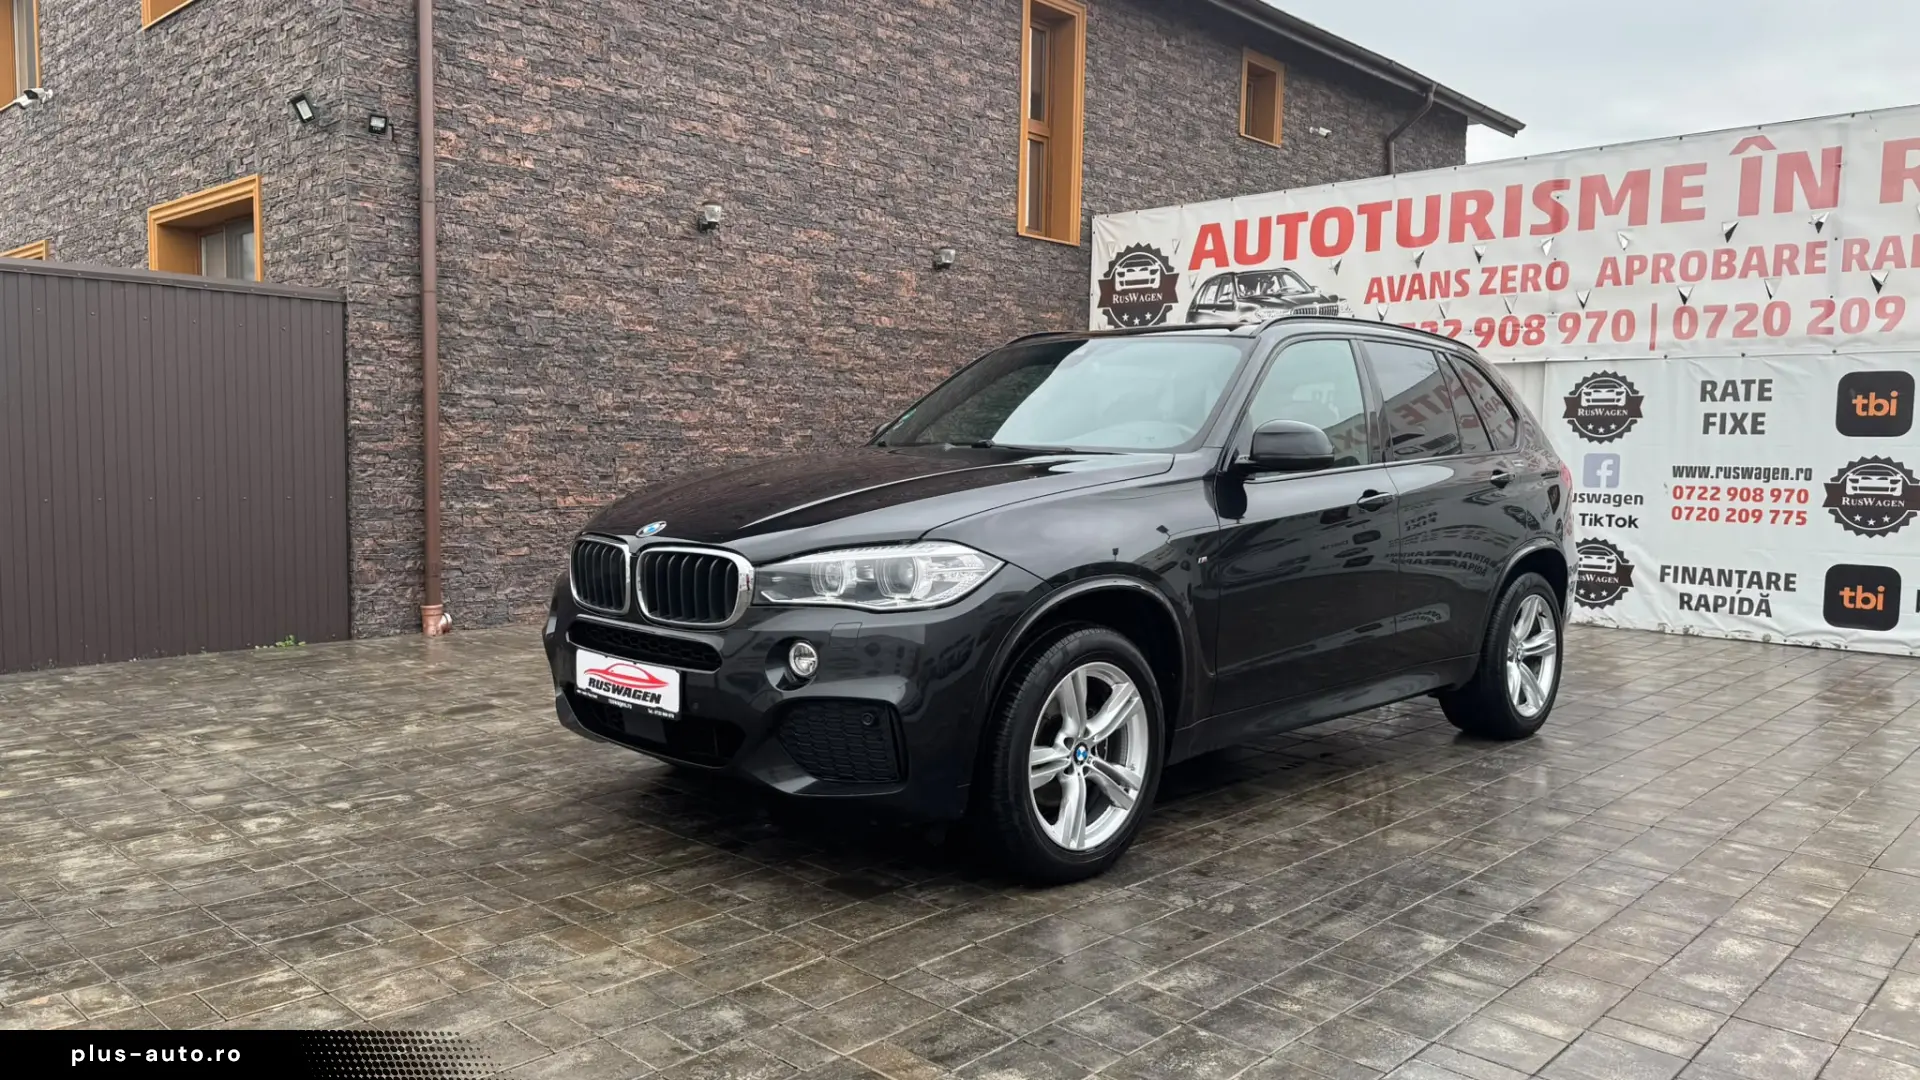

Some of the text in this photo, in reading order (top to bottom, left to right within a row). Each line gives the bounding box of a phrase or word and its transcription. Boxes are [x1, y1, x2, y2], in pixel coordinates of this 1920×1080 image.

[1188, 162, 1708, 271] AUTOTURISME
[1729, 135, 1843, 217] ÎN
[1363, 268, 1471, 304] AVANS
[1478, 259, 1571, 296] ZERO
[1595, 240, 1828, 288] APROBARE
[1473, 313, 1547, 349] 908
[1557, 308, 1637, 344] 970
[1672, 300, 1792, 340] 0720
[1806, 295, 1906, 336] 209
[1700, 379, 1773, 402] RATE
[1852, 391, 1898, 417] tbi
[1702, 412, 1766, 435] FIXE
[1672, 464, 1813, 483] www.ruswagen.ro
[1671, 485, 1810, 505] 0722 908 970
[1670, 505, 1808, 527] 0720 209 775
[1679, 591, 1773, 618] RAPIDĂ
[1839, 585, 1885, 611] tbi
[588, 677, 662, 705] RUSWAGEN
